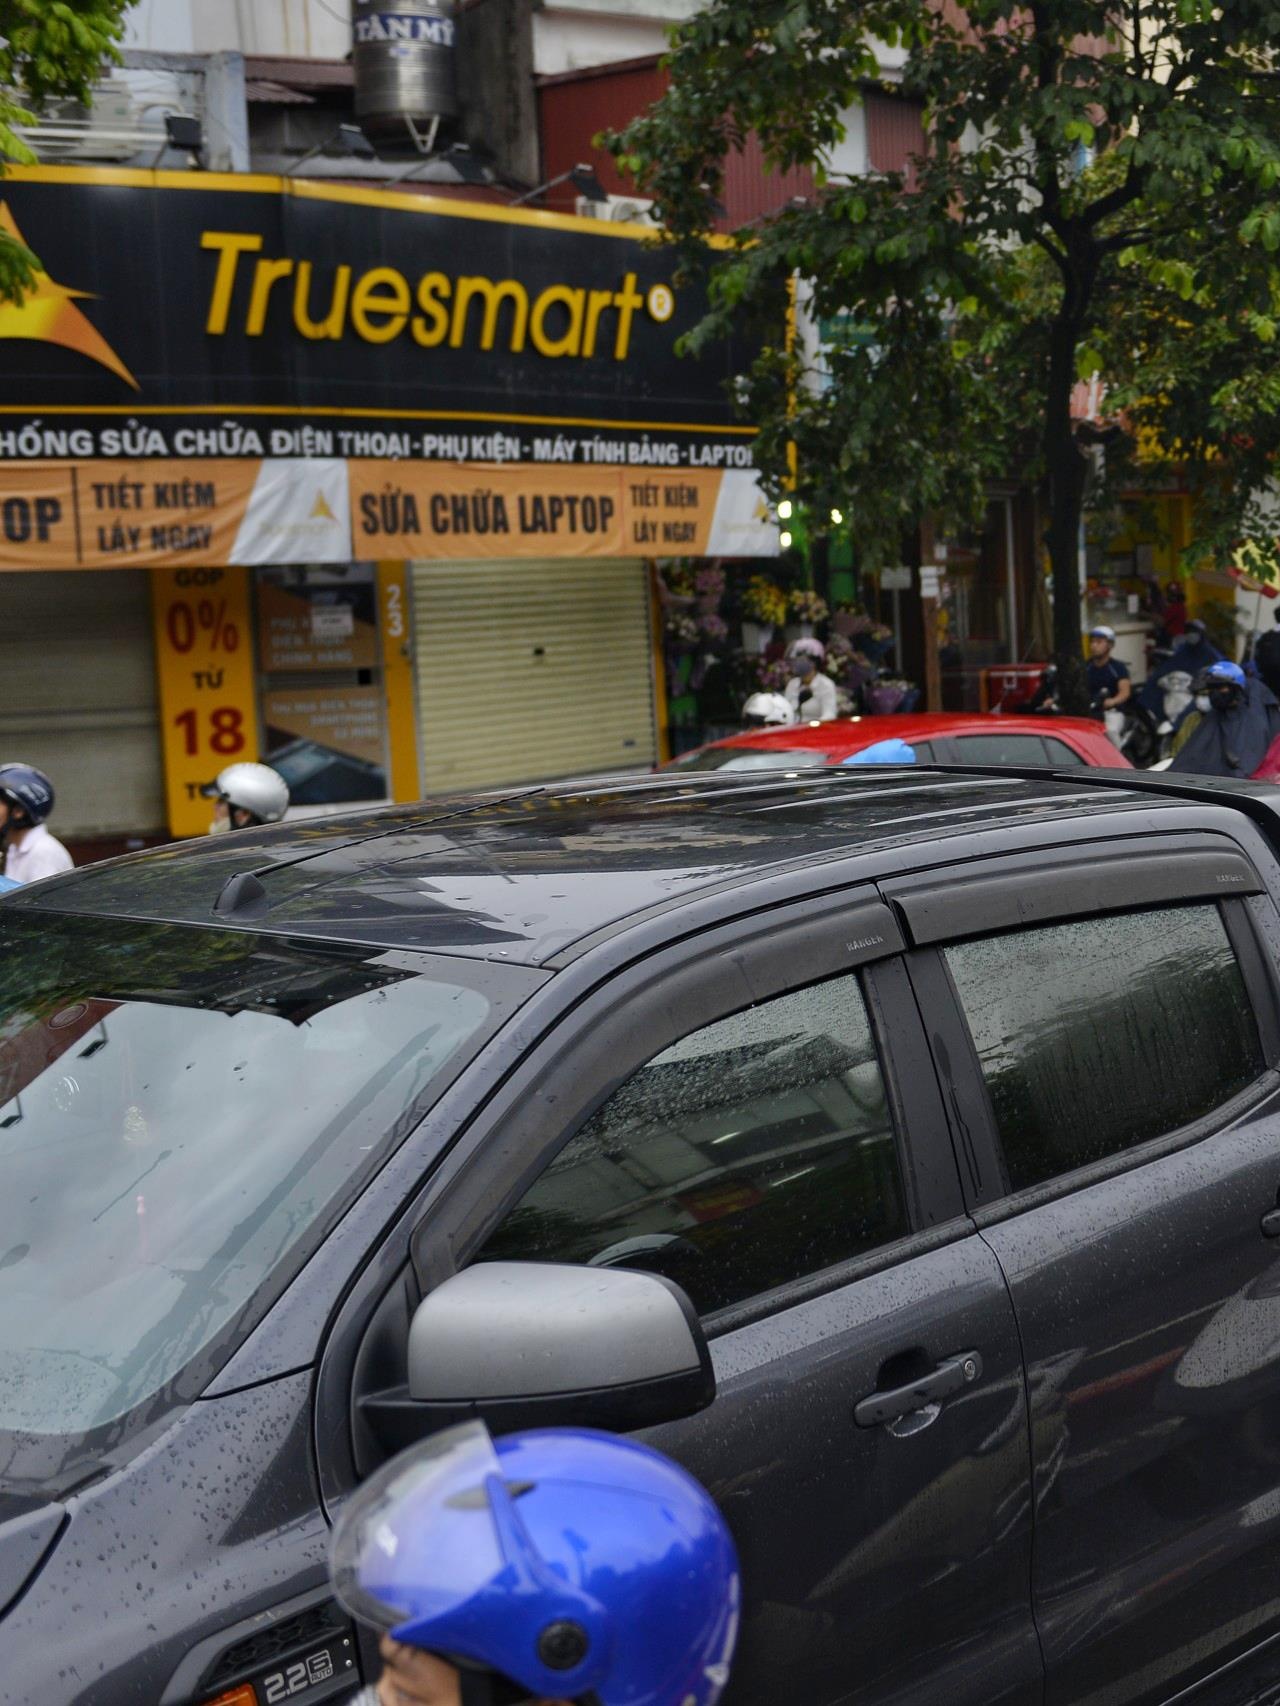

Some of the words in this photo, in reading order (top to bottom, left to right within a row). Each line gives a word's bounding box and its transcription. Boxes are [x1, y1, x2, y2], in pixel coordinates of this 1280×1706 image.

[201, 231, 643, 361] Truesmart
[100, 418, 169, 457] SỬA
[174, 420, 263, 456] CHỮA
[271, 425, 332, 457] ĐIỆN
[338, 430, 410, 461] THOẠI
[423, 434, 468, 463] PHỤ
[471, 432, 520, 464] KIỆN
[533, 434, 576, 461] MÁY
[581, 436, 625, 463] TÍNH
[628, 433, 679, 465] BẢNG
[91, 473, 145, 509] TIẾT
[360, 482, 421, 535] SỬA
[430, 489, 510, 535] CHỮA
[519, 495, 615, 534] LAPTOP
[631, 480, 658, 507] TIẾT
[98, 517, 140, 552] LẤY
[151, 526, 212, 549] NGAY
[633, 516, 657, 543] LẤY
[663, 521, 696, 543] NGAY
[168, 600, 240, 655] 0%
[174, 707, 245, 757] 18
[1216, 872, 1246, 882] RANGER
[846, 934, 884, 951] RANGER
[264, 1662, 308, 1704] 2.2
